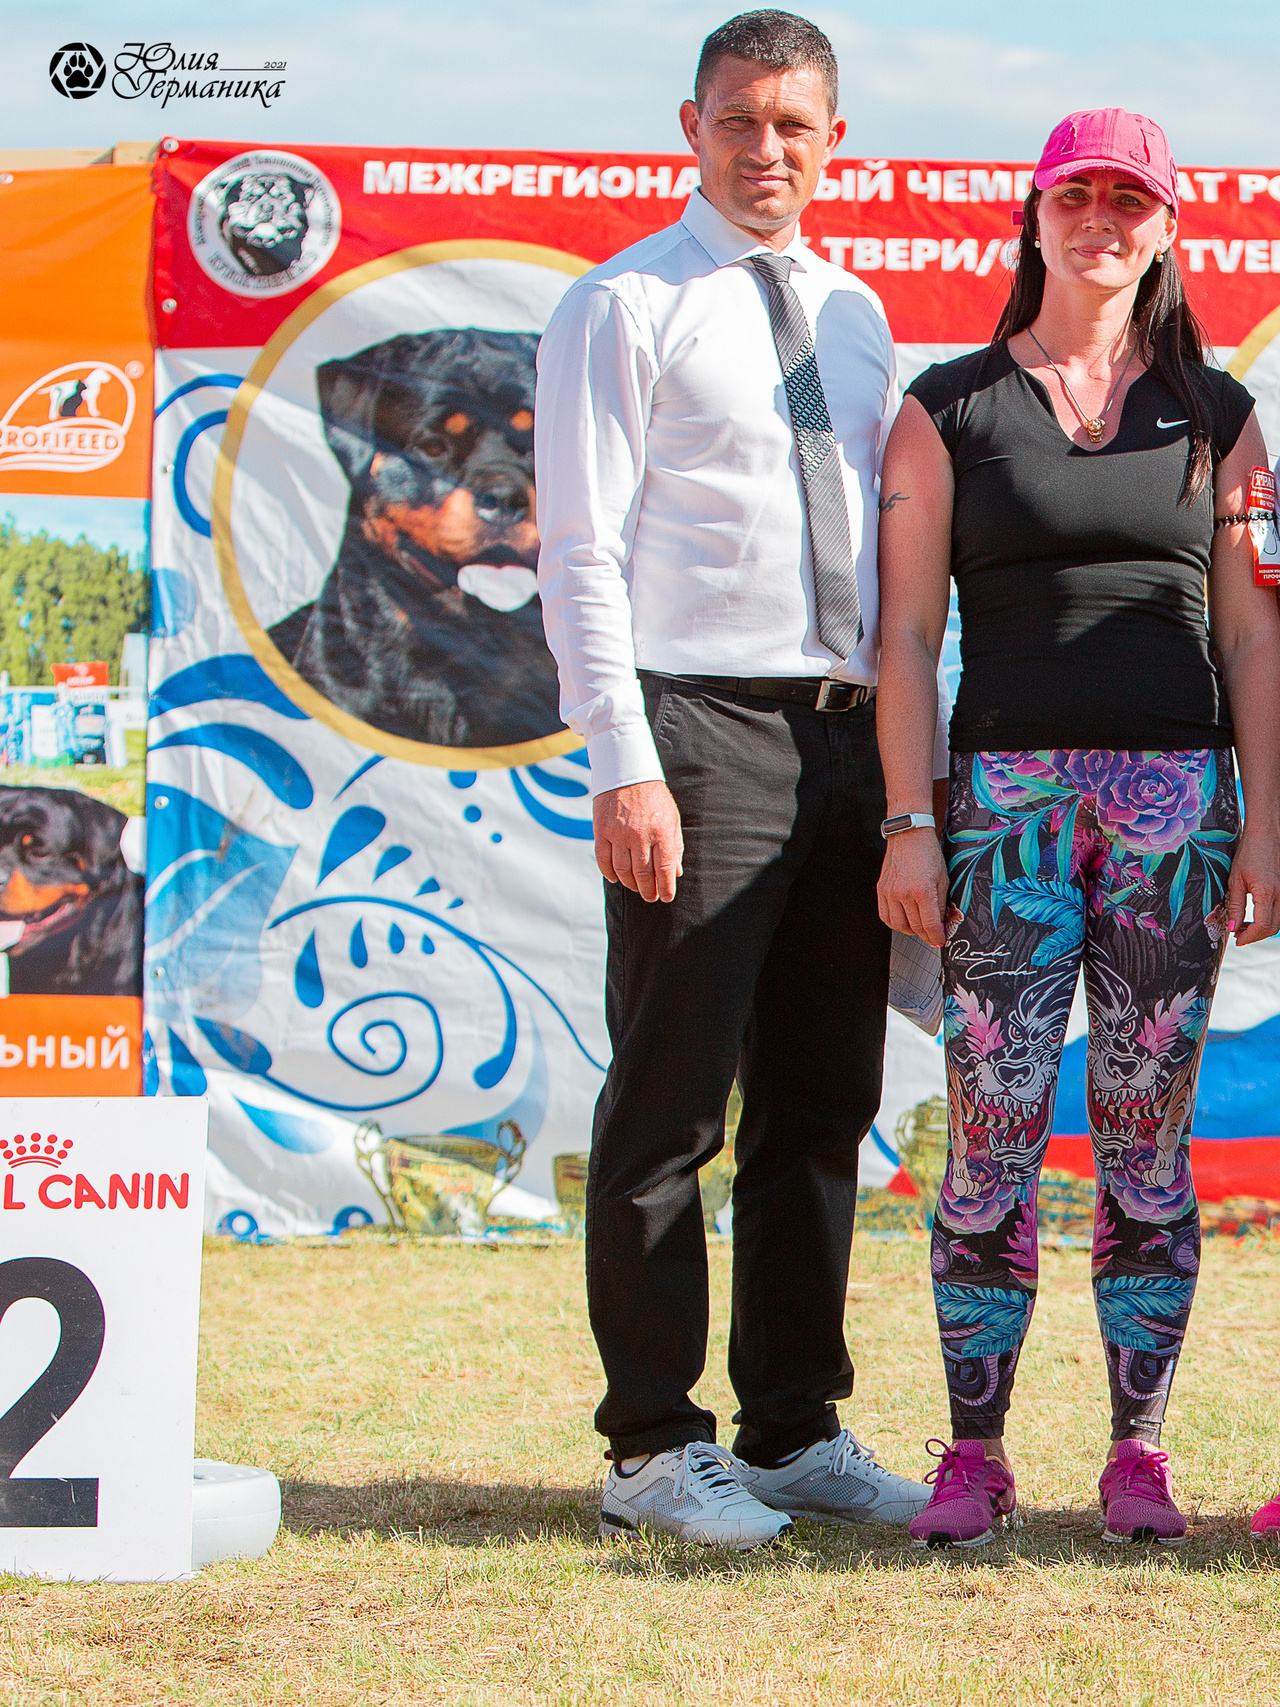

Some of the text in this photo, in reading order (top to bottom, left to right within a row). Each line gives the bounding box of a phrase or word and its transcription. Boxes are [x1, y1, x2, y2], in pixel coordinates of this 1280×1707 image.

[0, 430, 119, 450] ROFIFEED
[38, 1172, 190, 1210] CANIN
[0, 1257, 107, 1527] 2
